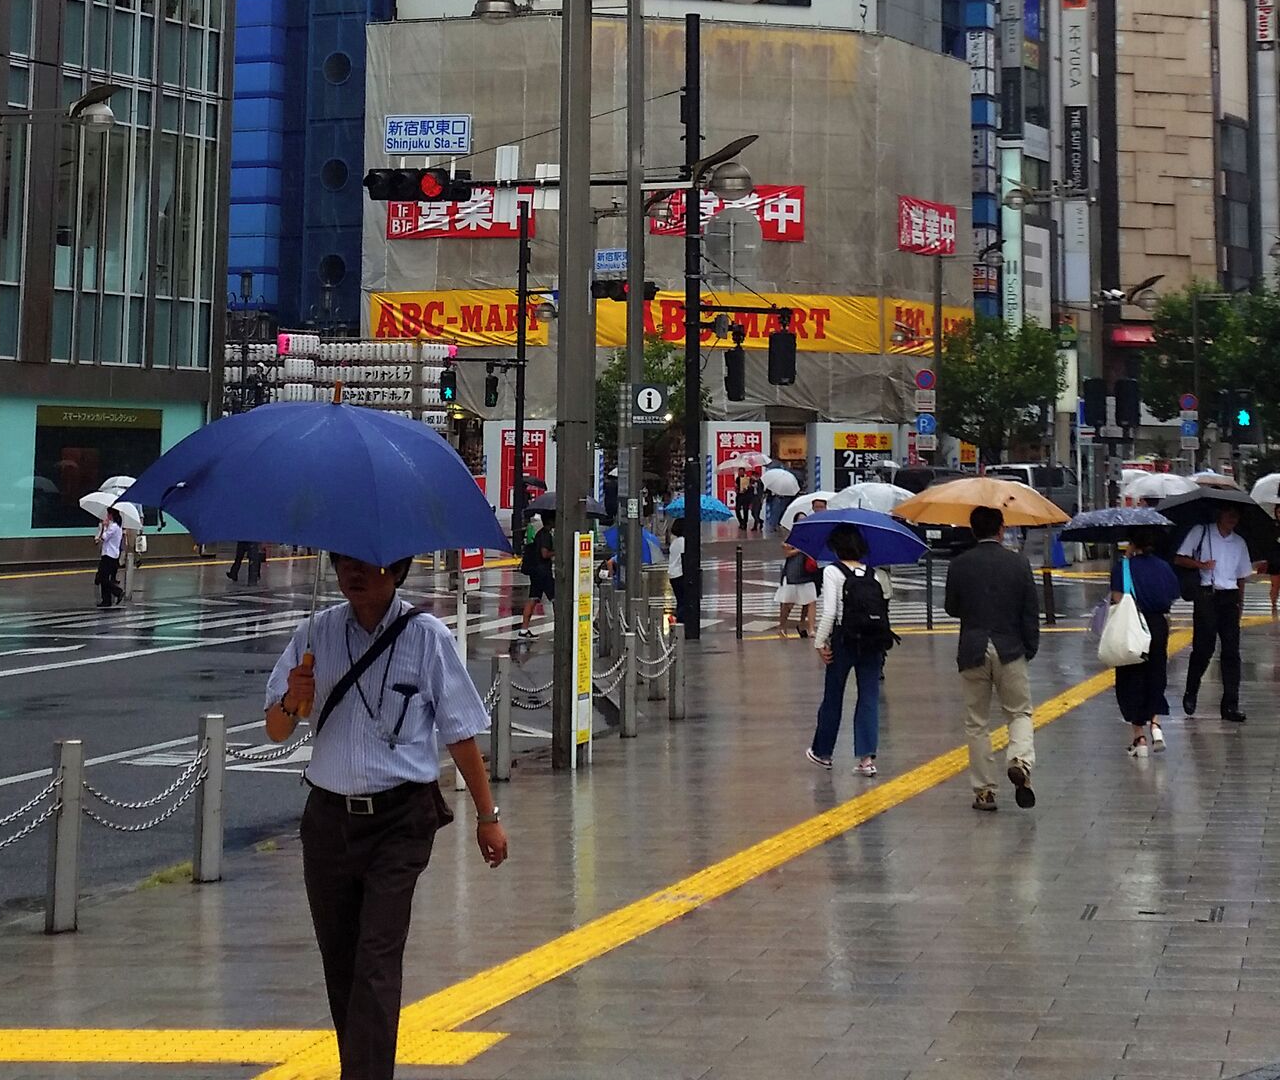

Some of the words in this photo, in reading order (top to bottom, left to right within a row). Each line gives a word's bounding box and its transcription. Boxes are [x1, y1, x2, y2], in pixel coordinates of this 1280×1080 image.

[387, 120, 466, 136] 新宿駅東口
[386, 137, 431, 150] Shinjuku
[397, 204, 409, 218] 1F
[911, 205, 956, 253] 営業中
[719, 433, 760, 449] 営業中
[845, 433, 889, 449] 営業中
[843, 450, 863, 468] 2F
